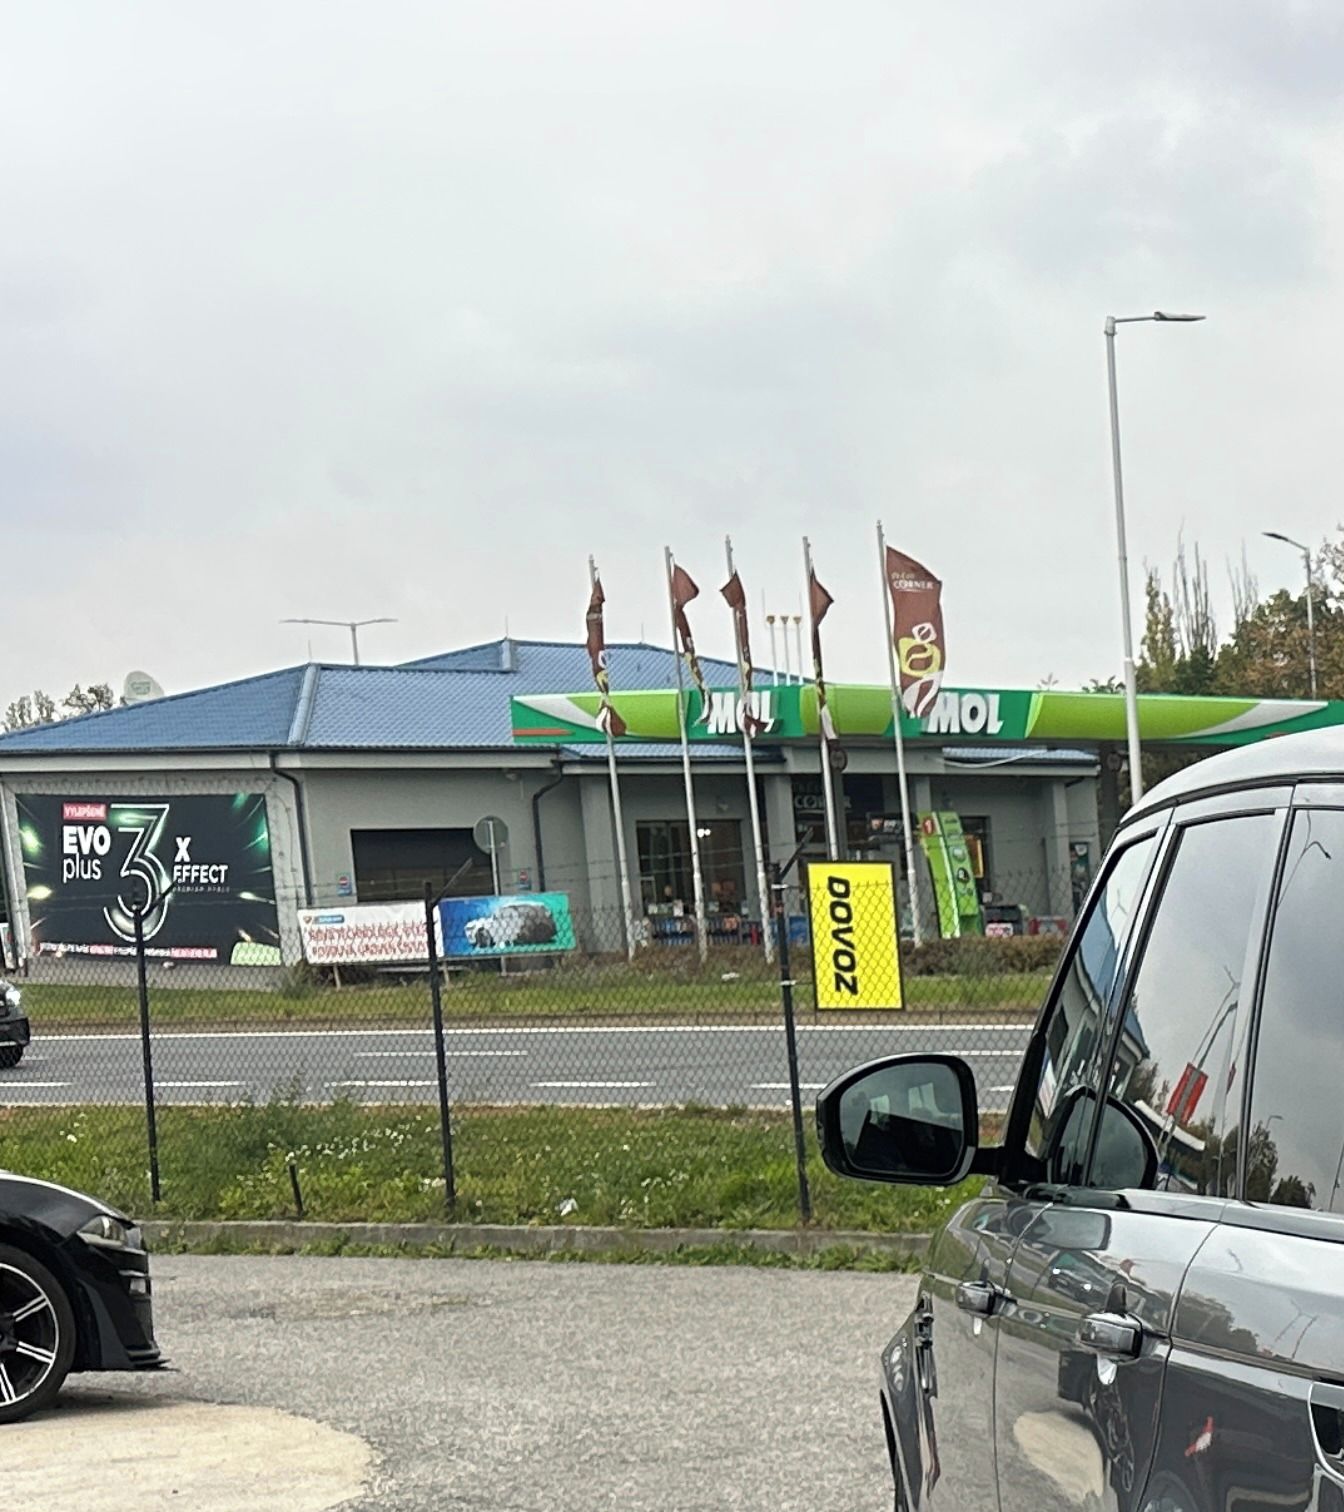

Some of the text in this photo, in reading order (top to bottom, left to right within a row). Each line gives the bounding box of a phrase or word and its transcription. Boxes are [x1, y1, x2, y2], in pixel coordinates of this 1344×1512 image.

[707, 691, 774, 734] MOL
[927, 693, 1004, 734] MOL
[63, 825, 111, 856] EVO
[174, 837, 191, 862] X
[63, 853, 101, 883] plus
[173, 864, 228, 884] EFFECT
[827, 875, 859, 995] DOVOZ
